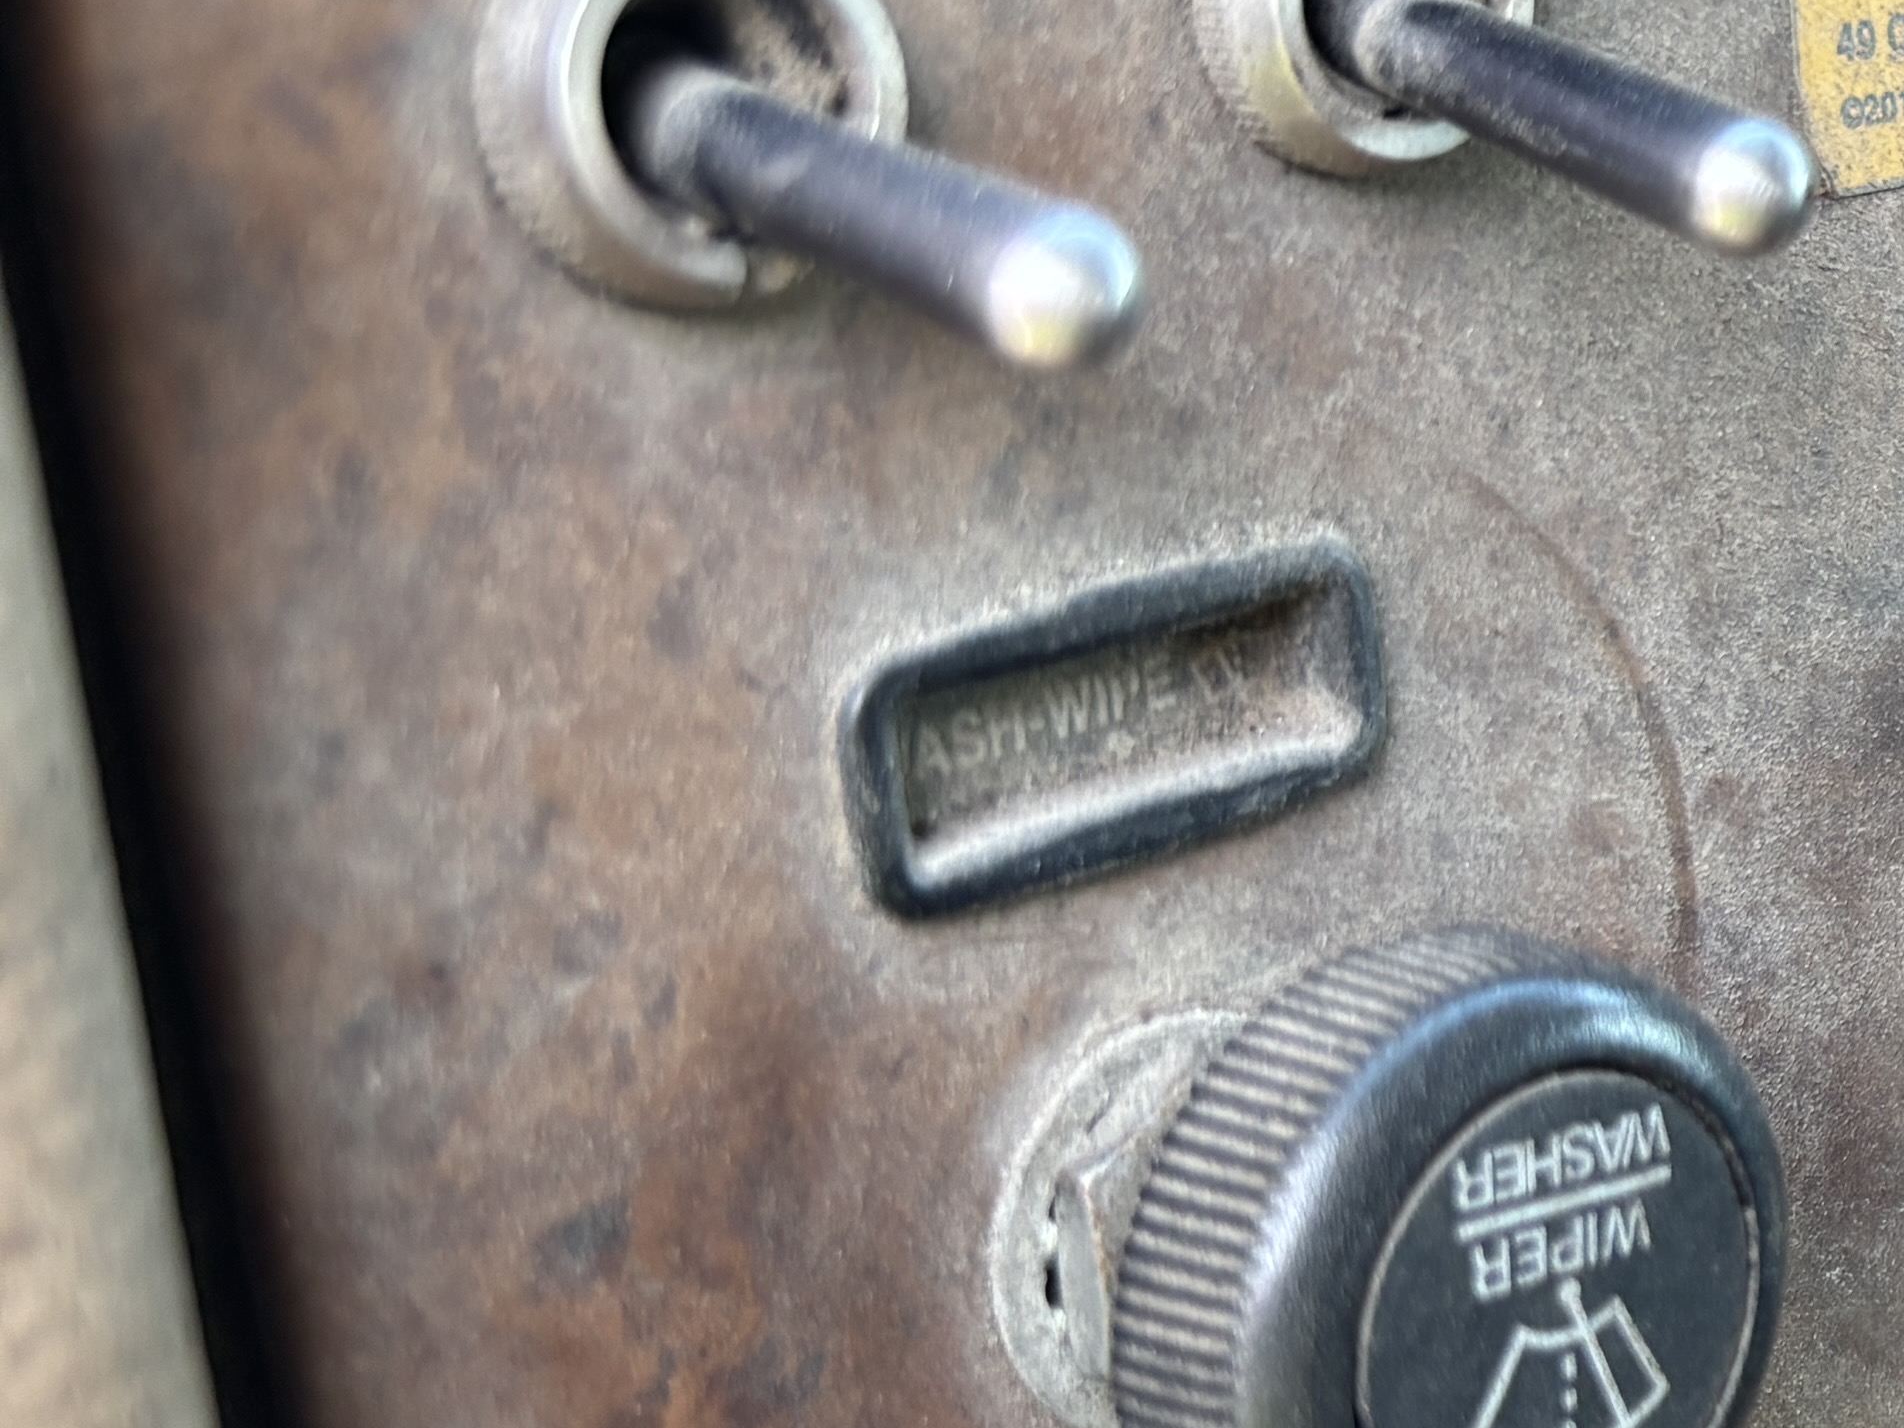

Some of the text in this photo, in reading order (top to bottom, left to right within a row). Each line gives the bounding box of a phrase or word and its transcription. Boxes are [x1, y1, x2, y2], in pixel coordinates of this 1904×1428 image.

[1836, 19, 1877, 63] 49
[905, 650, 1178, 774] ASH-WIPE
[1455, 1101, 1674, 1212] WASHER
[1471, 1196, 1654, 1302] WIPER
